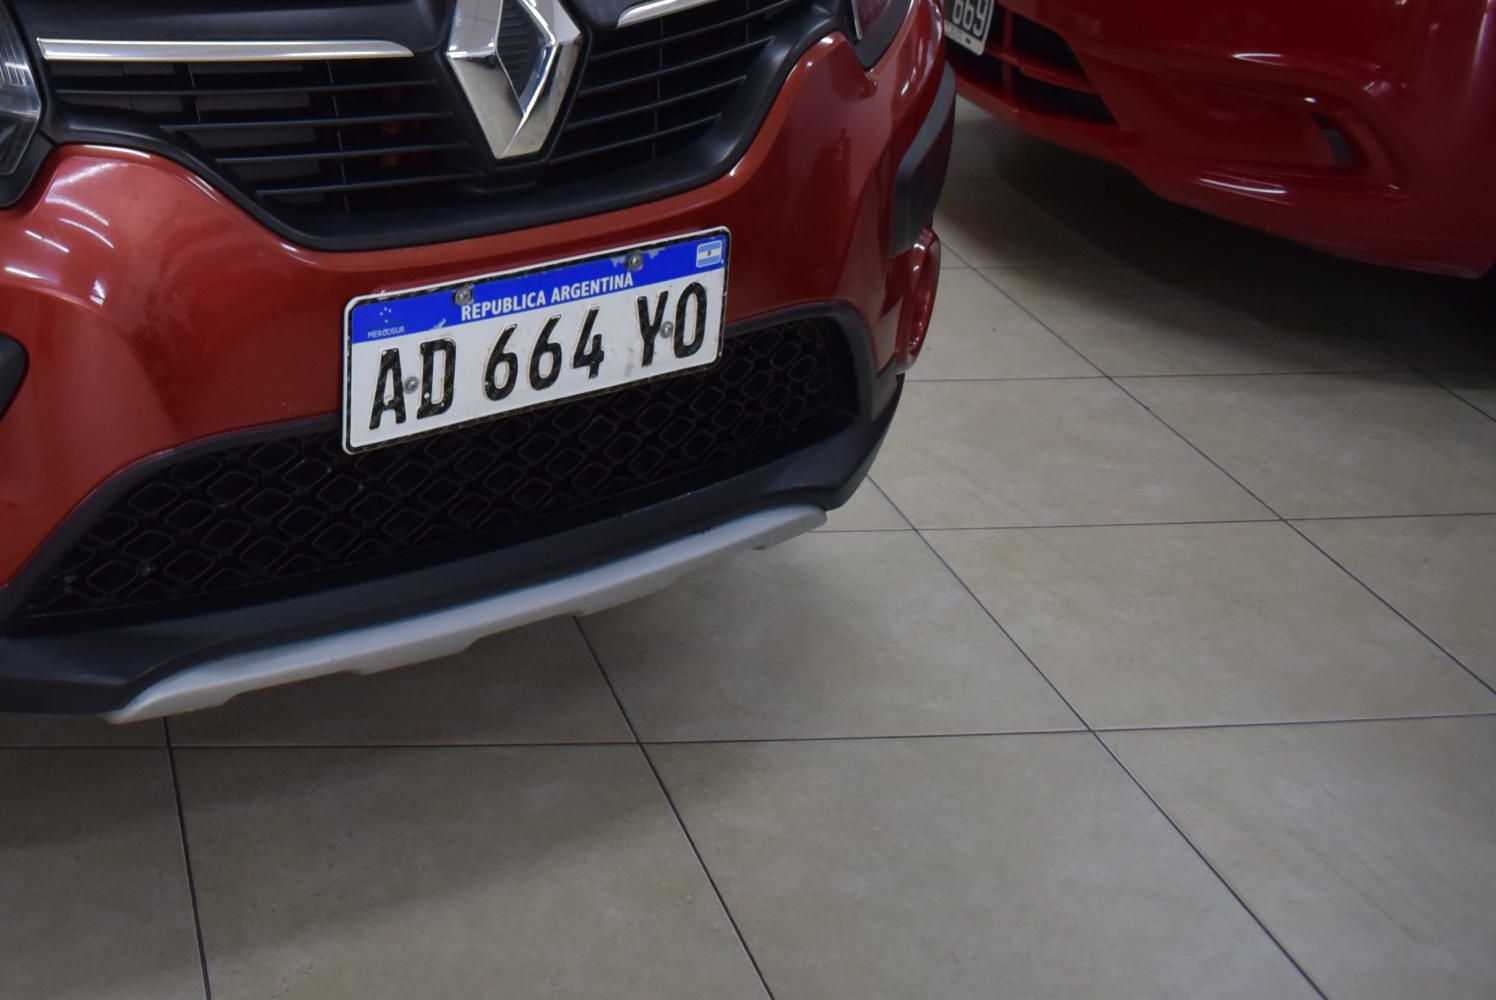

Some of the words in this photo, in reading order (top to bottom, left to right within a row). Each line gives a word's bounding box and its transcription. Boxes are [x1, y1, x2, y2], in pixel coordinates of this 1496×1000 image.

[461, 290, 546, 321] REPUBLICA
[551, 271, 633, 303] ARGENTINA
[367, 325, 405, 339] MERCOSUR
[368, 335, 457, 431] AD
[483, 304, 606, 402] 664
